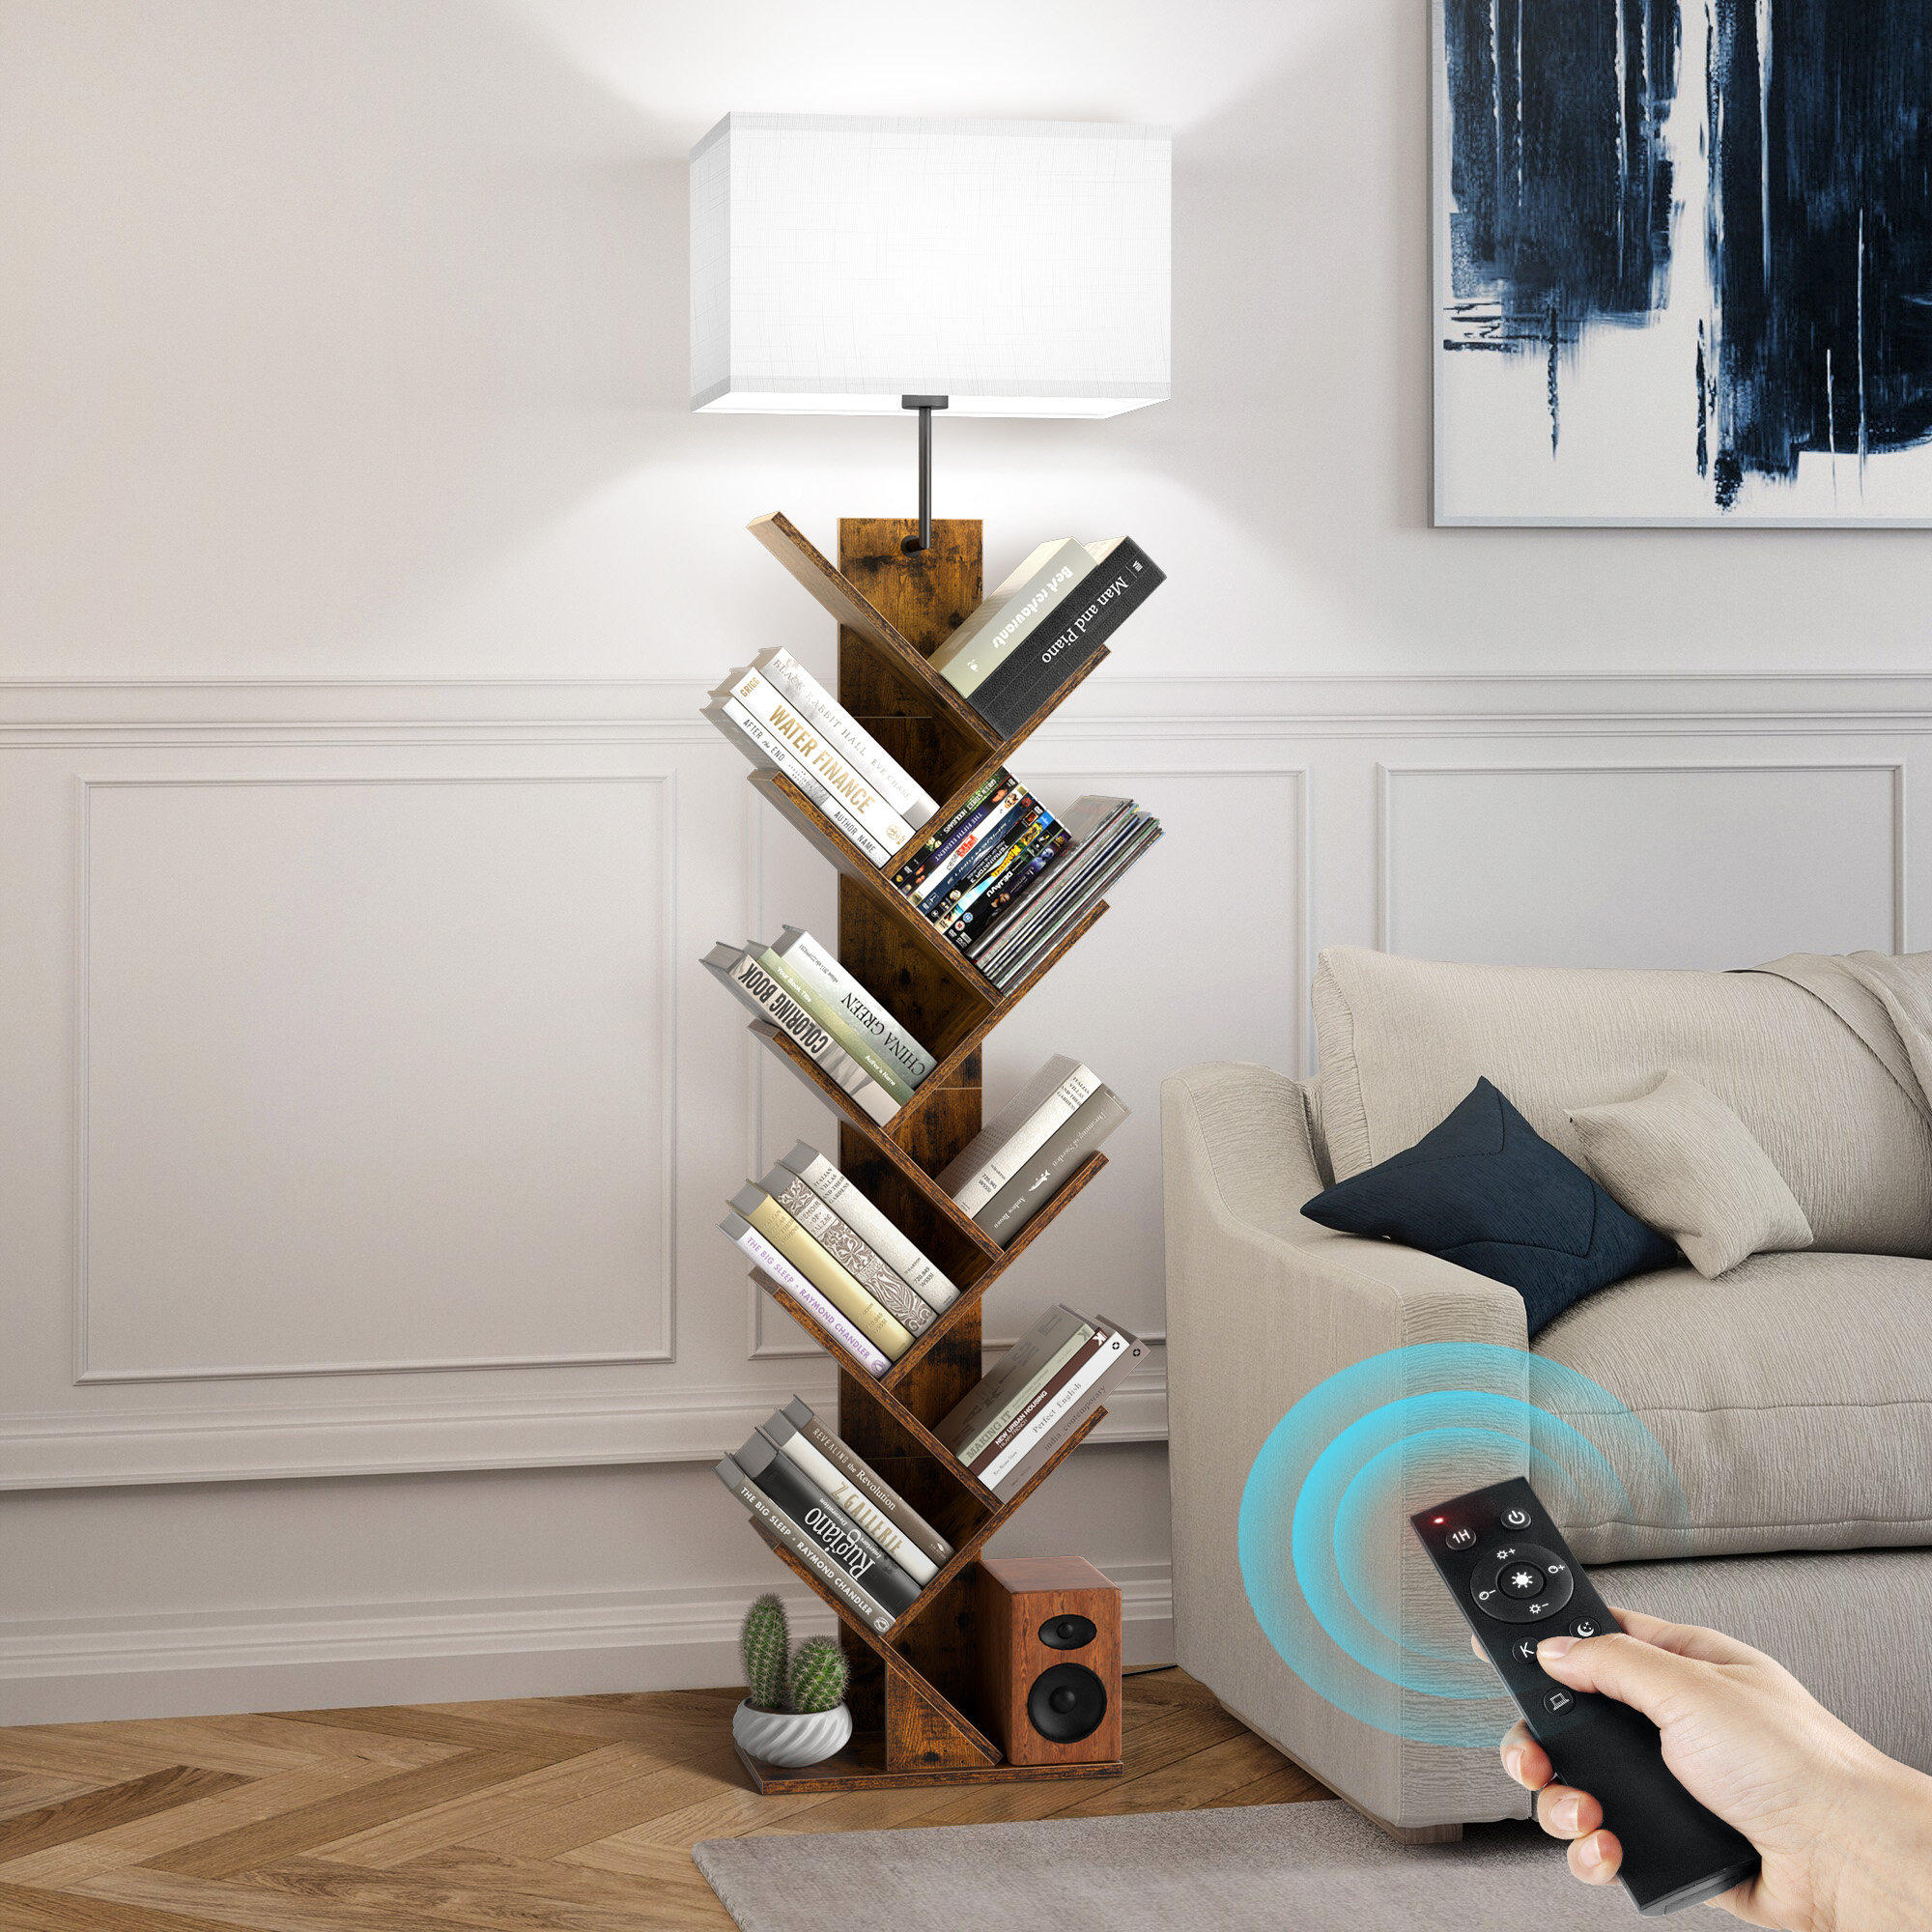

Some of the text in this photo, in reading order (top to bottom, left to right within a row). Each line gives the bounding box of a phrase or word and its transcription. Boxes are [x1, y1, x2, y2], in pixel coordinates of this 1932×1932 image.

[992, 566, 1074, 648] Best restaurants
[1041, 576, 1129, 663] Man and Piano
[740, 677, 760, 697] GRIGG
[773, 660, 804, 691] BLACK
[841, 728, 867, 756] HALL
[870, 759, 887, 776] EVE
[743, 719, 763, 740] AFTER
[771, 746, 785, 762] END
[769, 704, 818, 757] WATER
[812, 751, 875, 814] FINANCE
[834, 811, 875, 853] AUTHOR NAME
[956, 823, 972, 838] FIFTH
[971, 812, 982, 824] THE
[935, 838, 957, 861] ELEMENT
[738, 963, 772, 1003] BOOK
[777, 966, 787, 980] Your
[769, 997, 829, 1054] COLORING
[840, 992, 925, 1076] CHINA GREEN
[882, 1070, 895, 1087] Name
[814, 1168, 833, 1187] ITALIAN
[820, 1175, 838, 1191] VILLAS
[829, 1182, 850, 1204] GARDENS
[748, 1237, 761, 1252] THE
[760, 1251, 774, 1265] BIG
[774, 1264, 794, 1284] SLEEP
[799, 1289, 835, 1324] RAYMOND
[835, 1322, 869, 1359] CHANDLER
[994, 1432, 1009, 1446] NEW
[1007, 1412, 1026, 1435] URBAN
[1023, 1390, 1048, 1418] HOUSING
[1033, 1408, 1057, 1434] Perfect
[1057, 1381, 1082, 1409] English
[966, 1410, 1012, 1459] MAKING IT
[812, 1428, 896, 1511] REVEALING the Revolution
[819, 1497, 847, 1527] Decoration
[830, 1481, 846, 1500] Z
[843, 1492, 903, 1557] GALLERIE
[740, 1488, 873, 1616] THE BIG SLEEP RAYMOND CHANDLER
[805, 1507, 876, 1581] Rugiano
[1452, 1529, 1470, 1544] 1H
[1520, 1641, 1535, 1659] K
